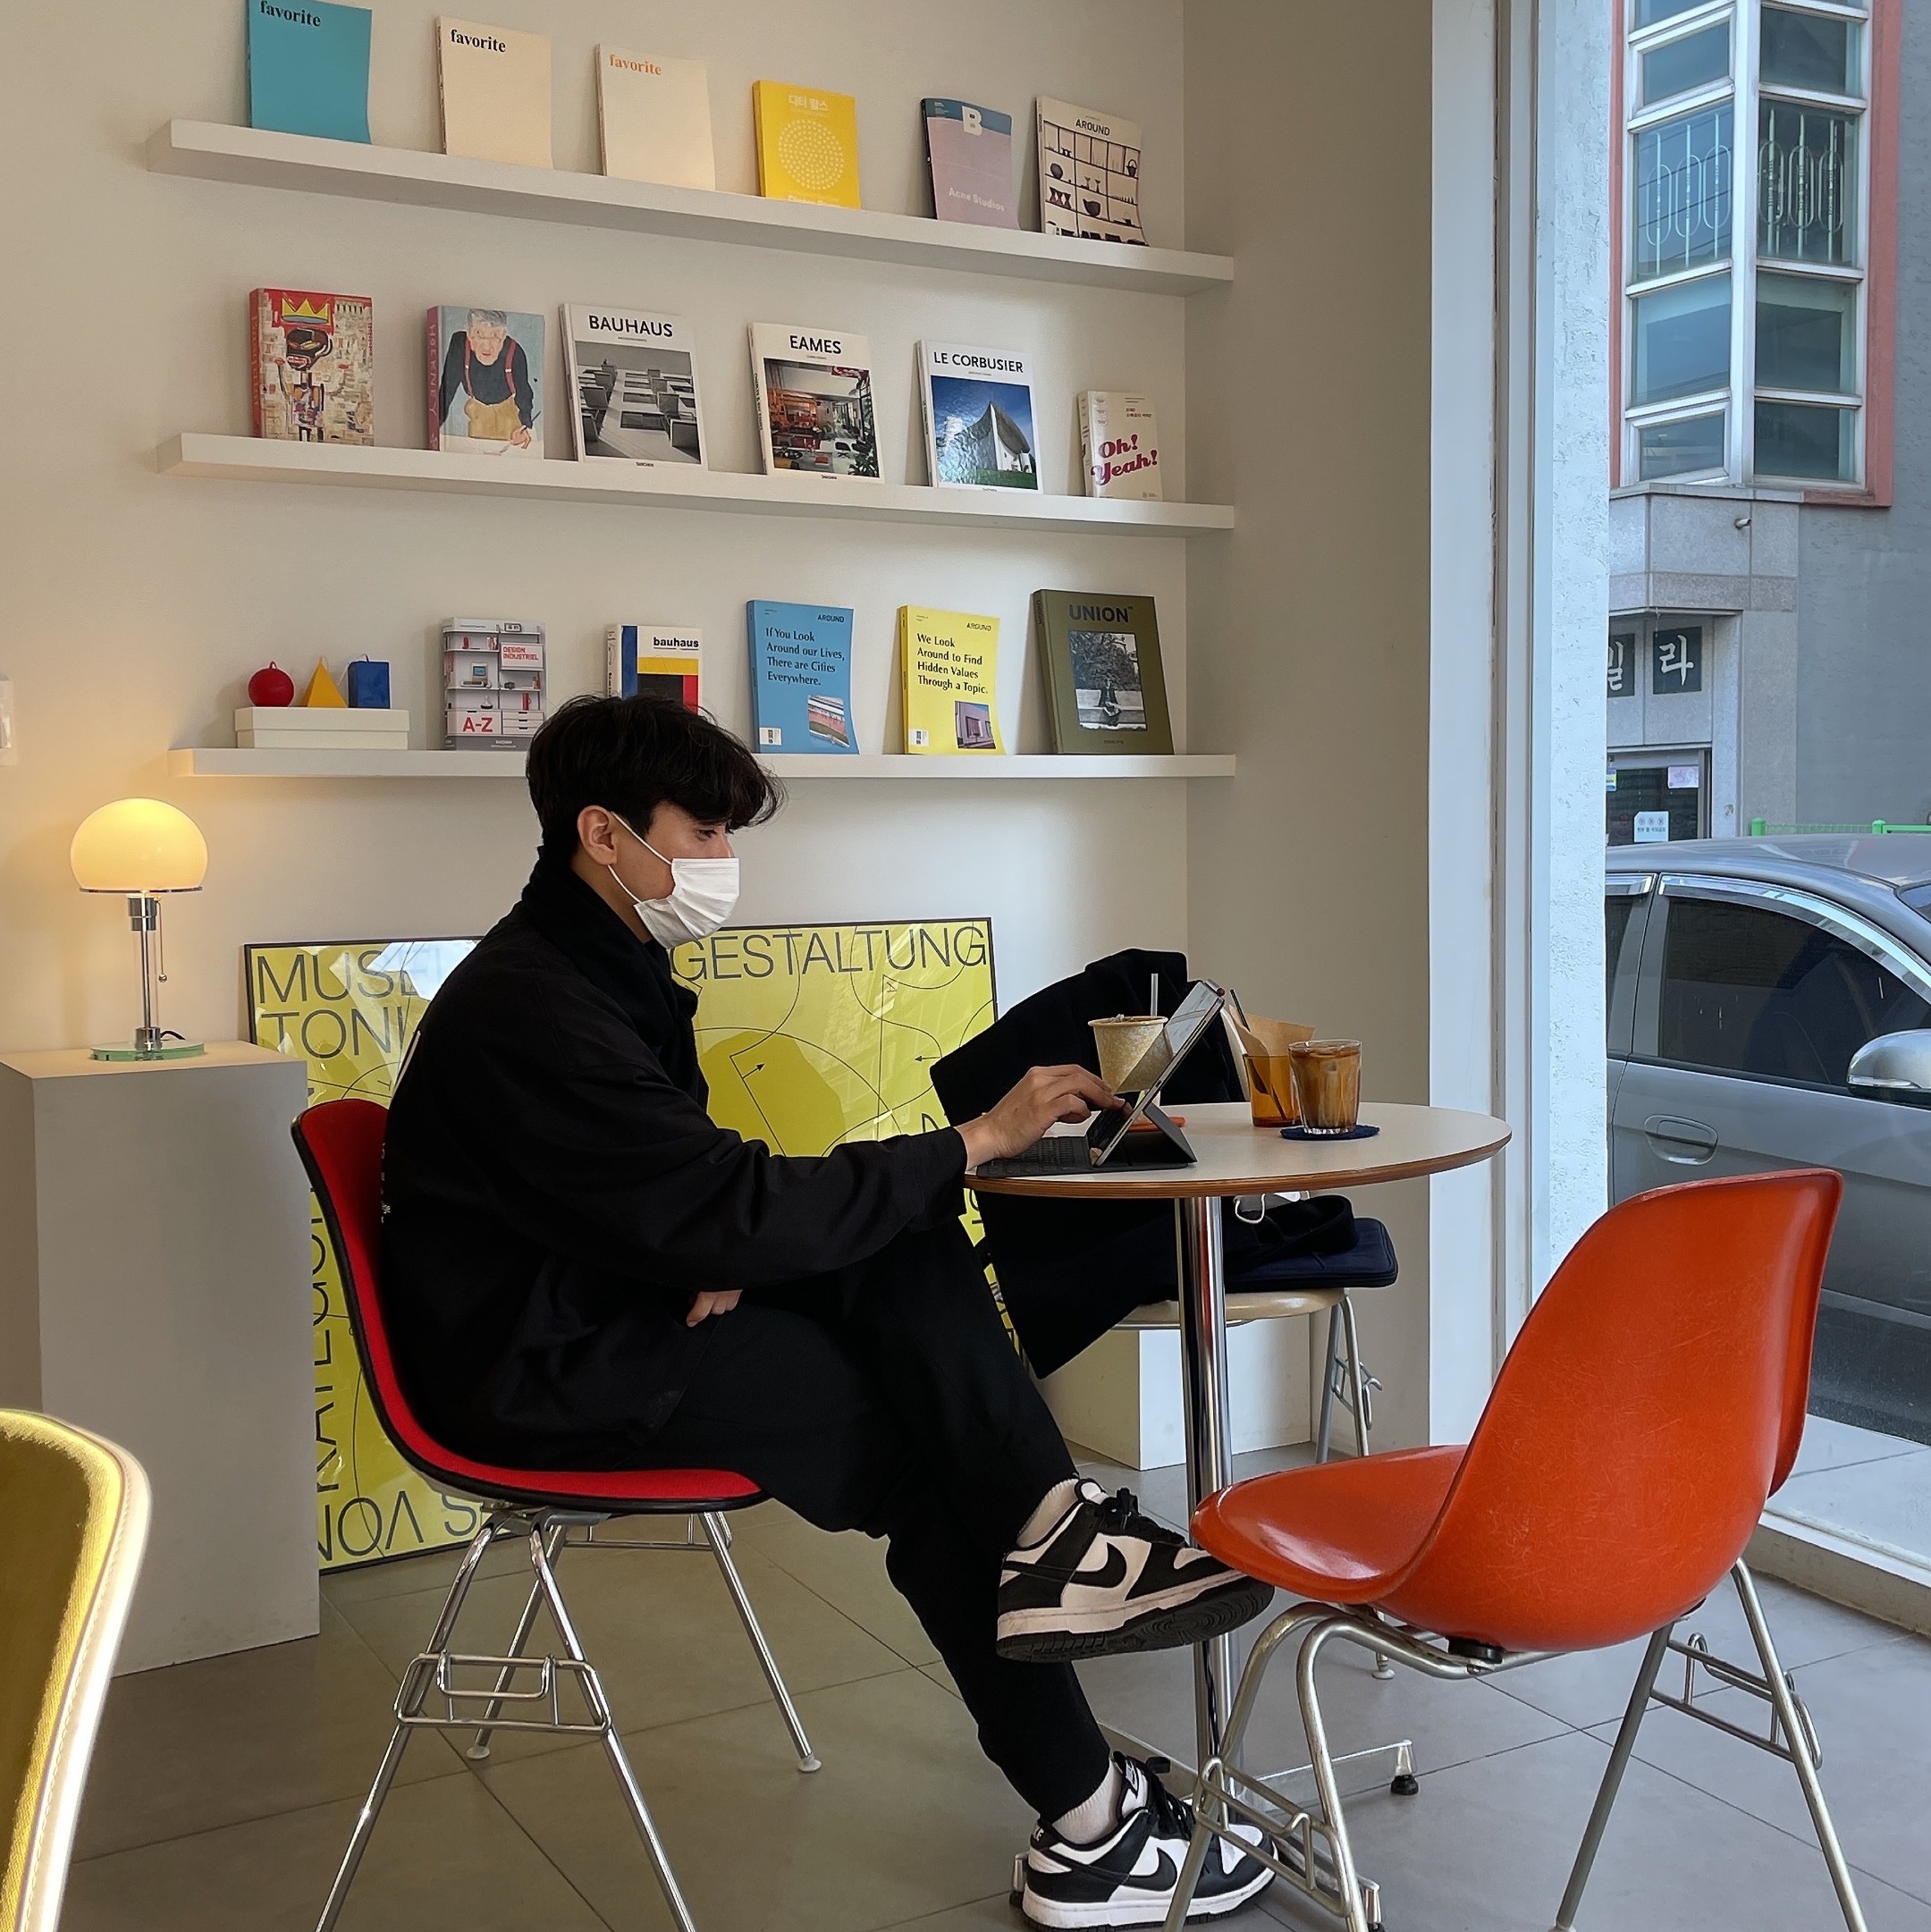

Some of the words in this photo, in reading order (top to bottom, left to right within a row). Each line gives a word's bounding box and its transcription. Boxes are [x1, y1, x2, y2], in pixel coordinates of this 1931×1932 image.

[259, 0, 321, 28] favorite
[450, 29, 506, 54] favorite
[609, 54, 662, 77] favorite
[961, 105, 983, 136] B
[1075, 118, 1110, 136] AROUND
[949, 187, 971, 200] Acne
[973, 193, 1006, 212] Studios
[588, 315, 673, 338] BAUHAUS
[789, 334, 842, 355] EAMES
[933, 351, 949, 365] LE
[952, 353, 1024, 374] CORBUSIER
[1098, 434, 1139, 459] Oh!
[1090, 449, 1159, 486] Yeah!
[817, 614, 845, 623] AROUND
[966, 622, 992, 632] AROUND
[653, 637, 700, 648] bauhaus
[765, 627, 773, 637] If
[774, 628, 790, 639] You
[793, 630, 815, 642] Look
[916, 633, 932, 645] We
[934, 636, 956, 648] Look
[766, 642, 800, 654] Around
[802, 648, 818, 657] our
[820, 647, 845, 662] Lives,
[916, 646, 949, 661] Around
[952, 653, 961, 662] to
[964, 654, 982, 665] Find
[766, 656, 793, 669] There
[794, 662, 809, 670] are
[811, 661, 836, 672] Cities
[917, 661, 949, 675] Hidden
[950, 666, 979, 679] Values
[767, 671, 822, 686] Everywhere.
[917, 675, 953, 691] Through
[955, 682, 961, 690] a
[963, 681, 989, 696] Topic.
[462, 716, 493, 733] A-Z
[671, 925, 988, 981] GESTALTUNG
[257, 949, 436, 1005] MUSE
